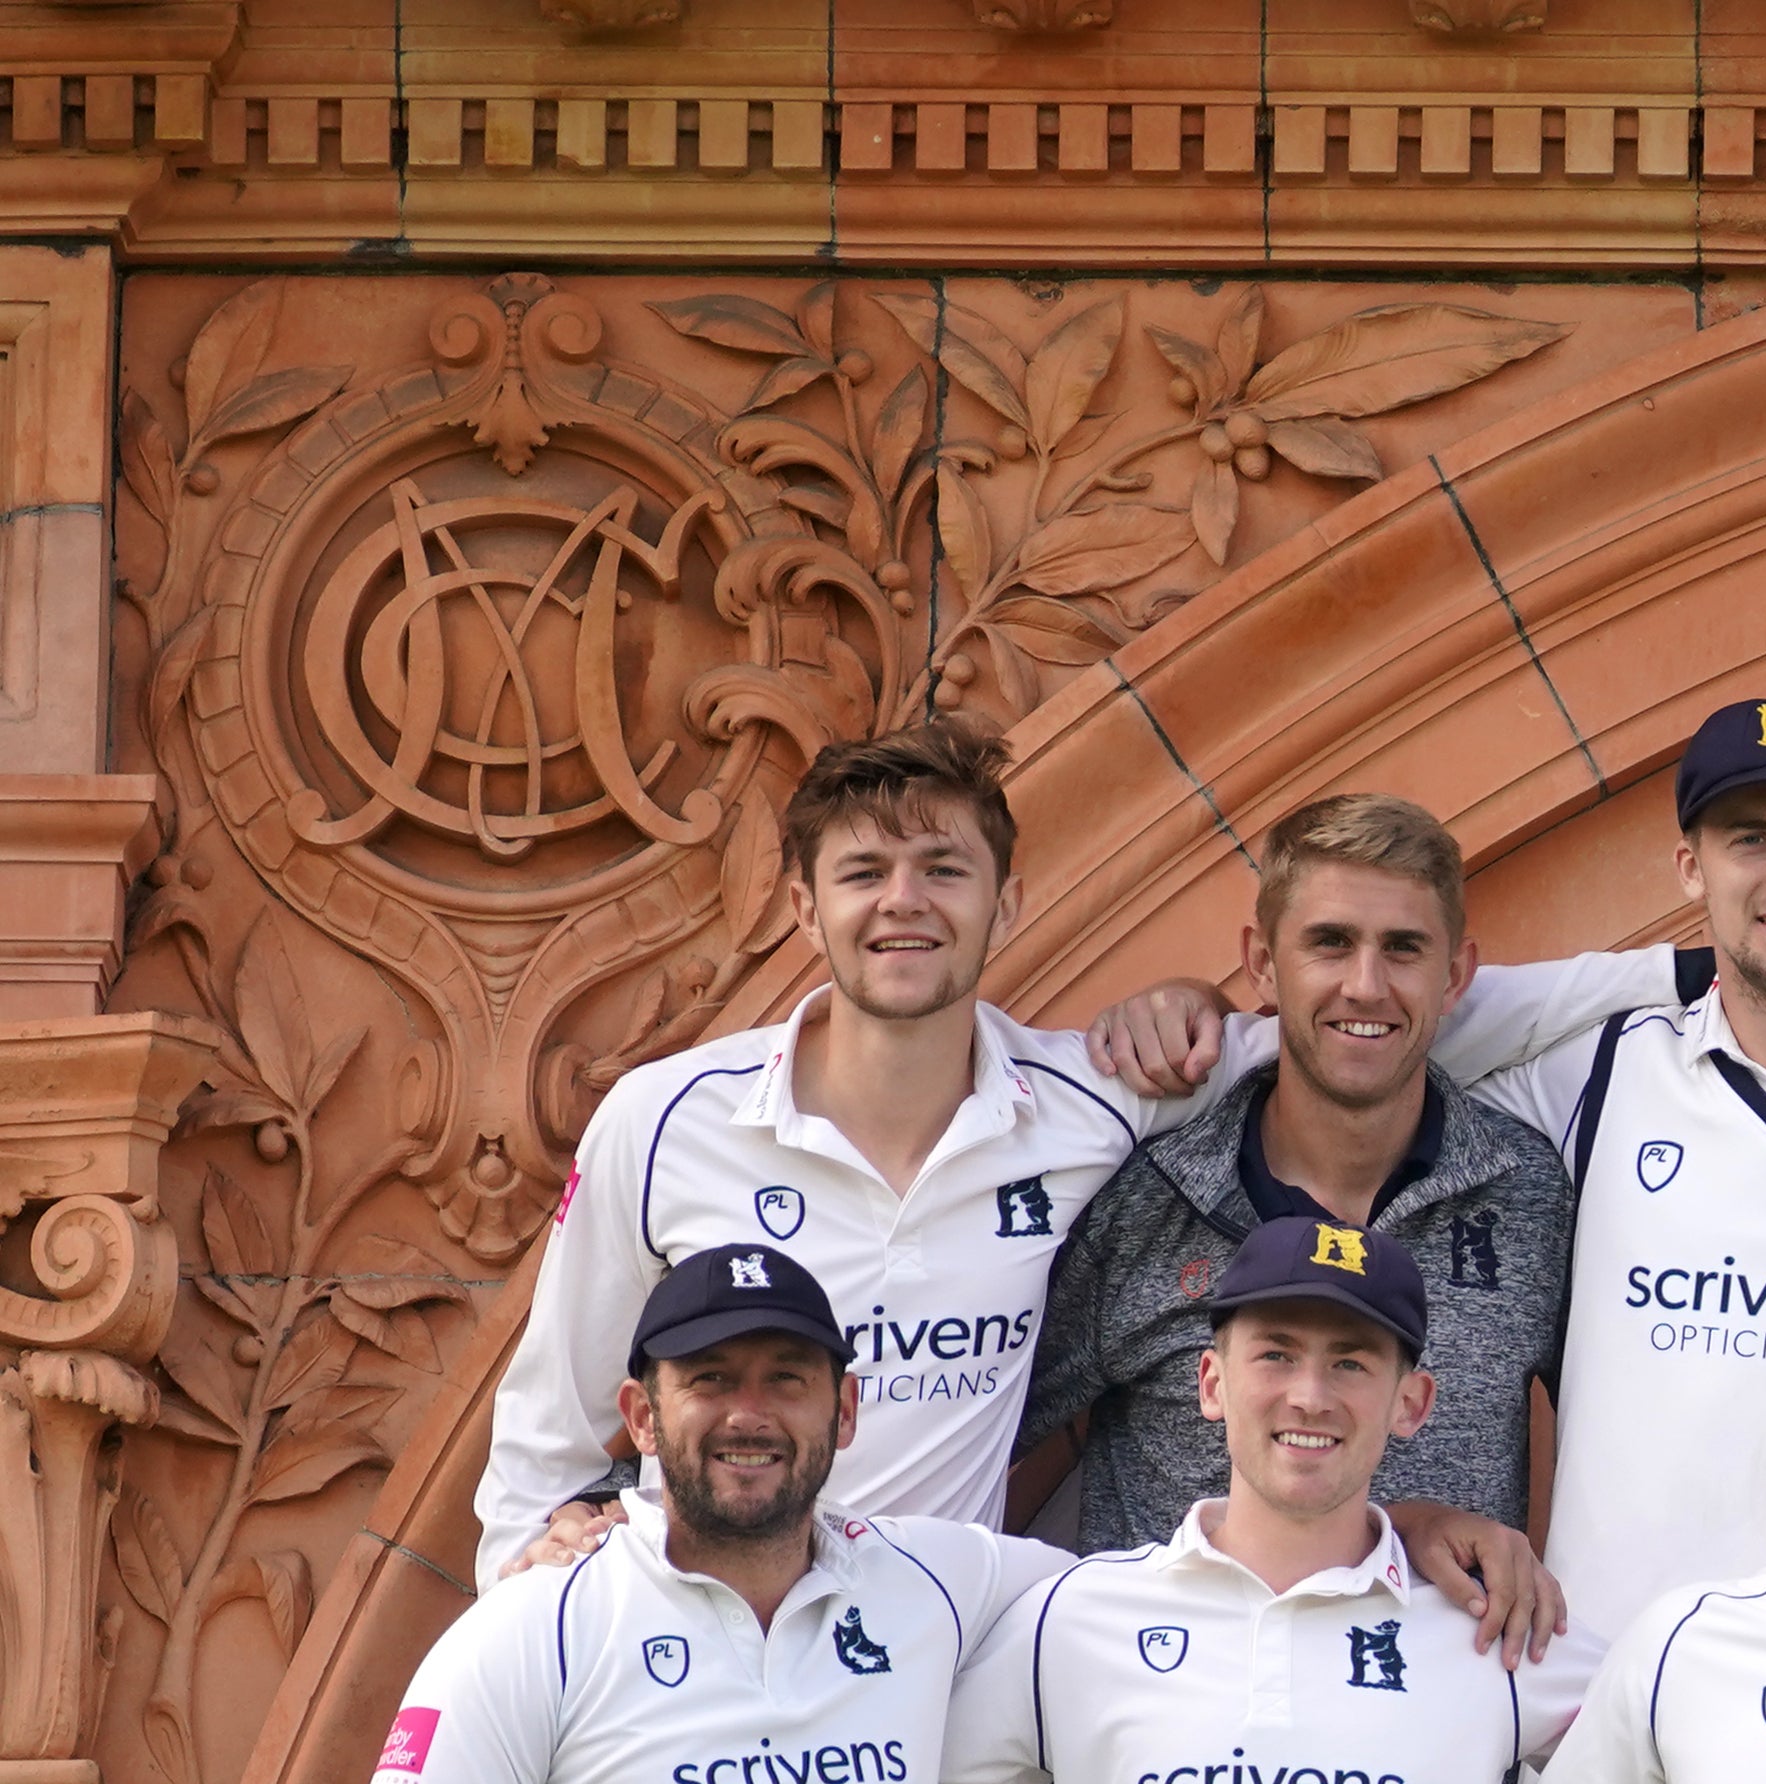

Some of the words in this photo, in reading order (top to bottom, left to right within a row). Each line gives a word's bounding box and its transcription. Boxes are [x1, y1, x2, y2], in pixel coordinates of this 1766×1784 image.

[1644, 1149, 1667, 1162] PL
[763, 1194, 788, 1209] PL
[845, 1305, 1033, 1362] rivens
[859, 1367, 998, 1403] TICIANS
[1147, 1632, 1171, 1646] PL
[651, 1645, 672, 1658] PL
